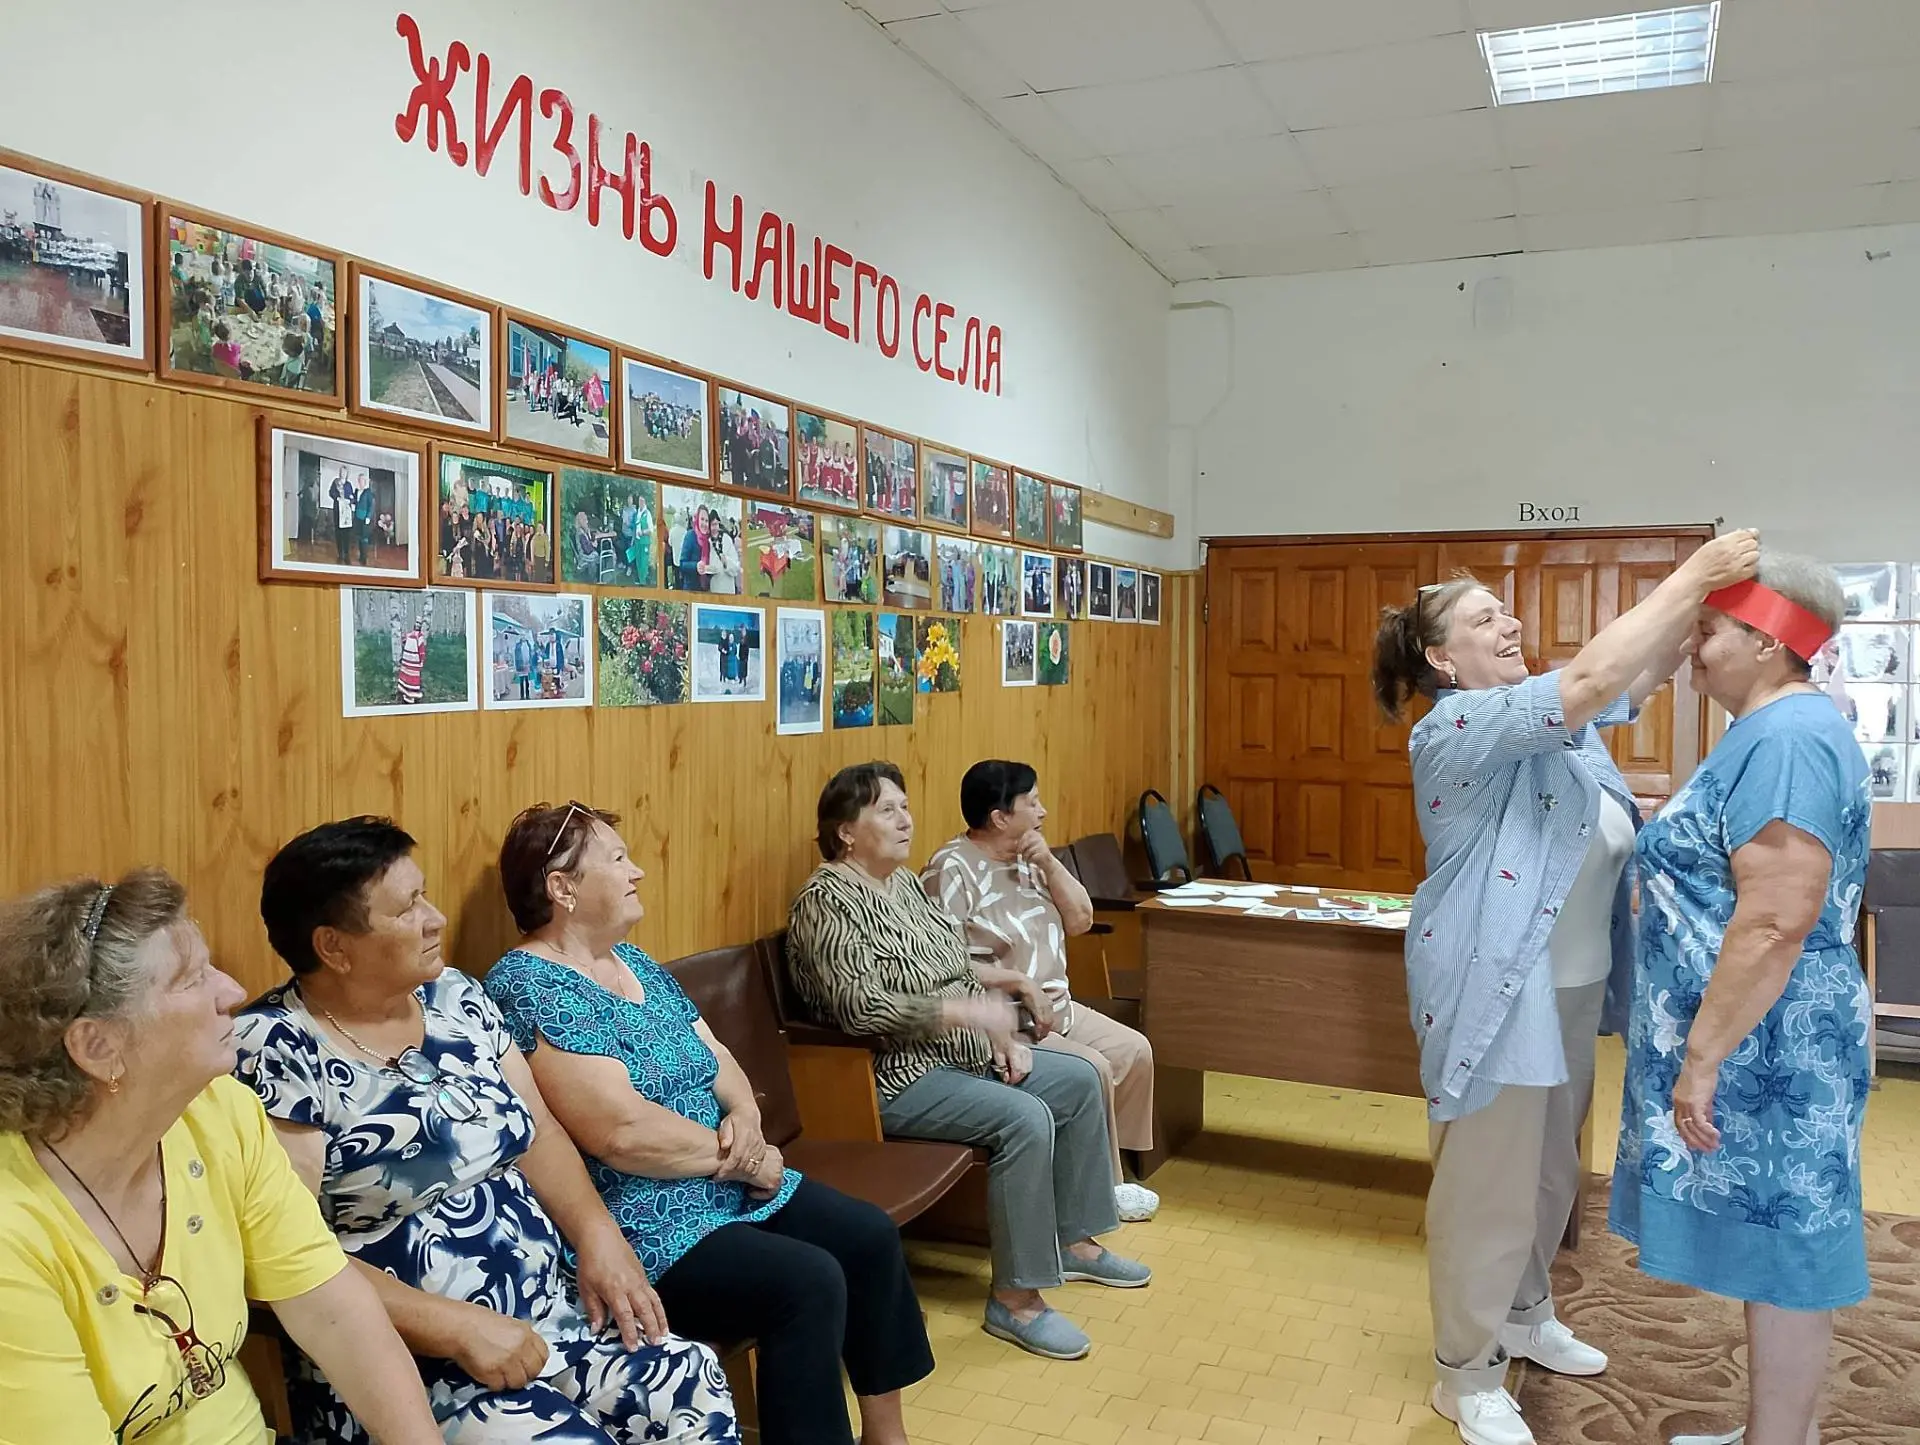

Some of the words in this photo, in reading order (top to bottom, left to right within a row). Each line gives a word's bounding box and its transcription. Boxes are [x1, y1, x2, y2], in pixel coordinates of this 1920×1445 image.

[396, 13, 678, 257] ЖИЗНЬ
[703, 180, 901, 358] НАШЕГО
[912, 294, 1001, 396] СЕЛА
[1519, 502, 1580, 522] Вход
